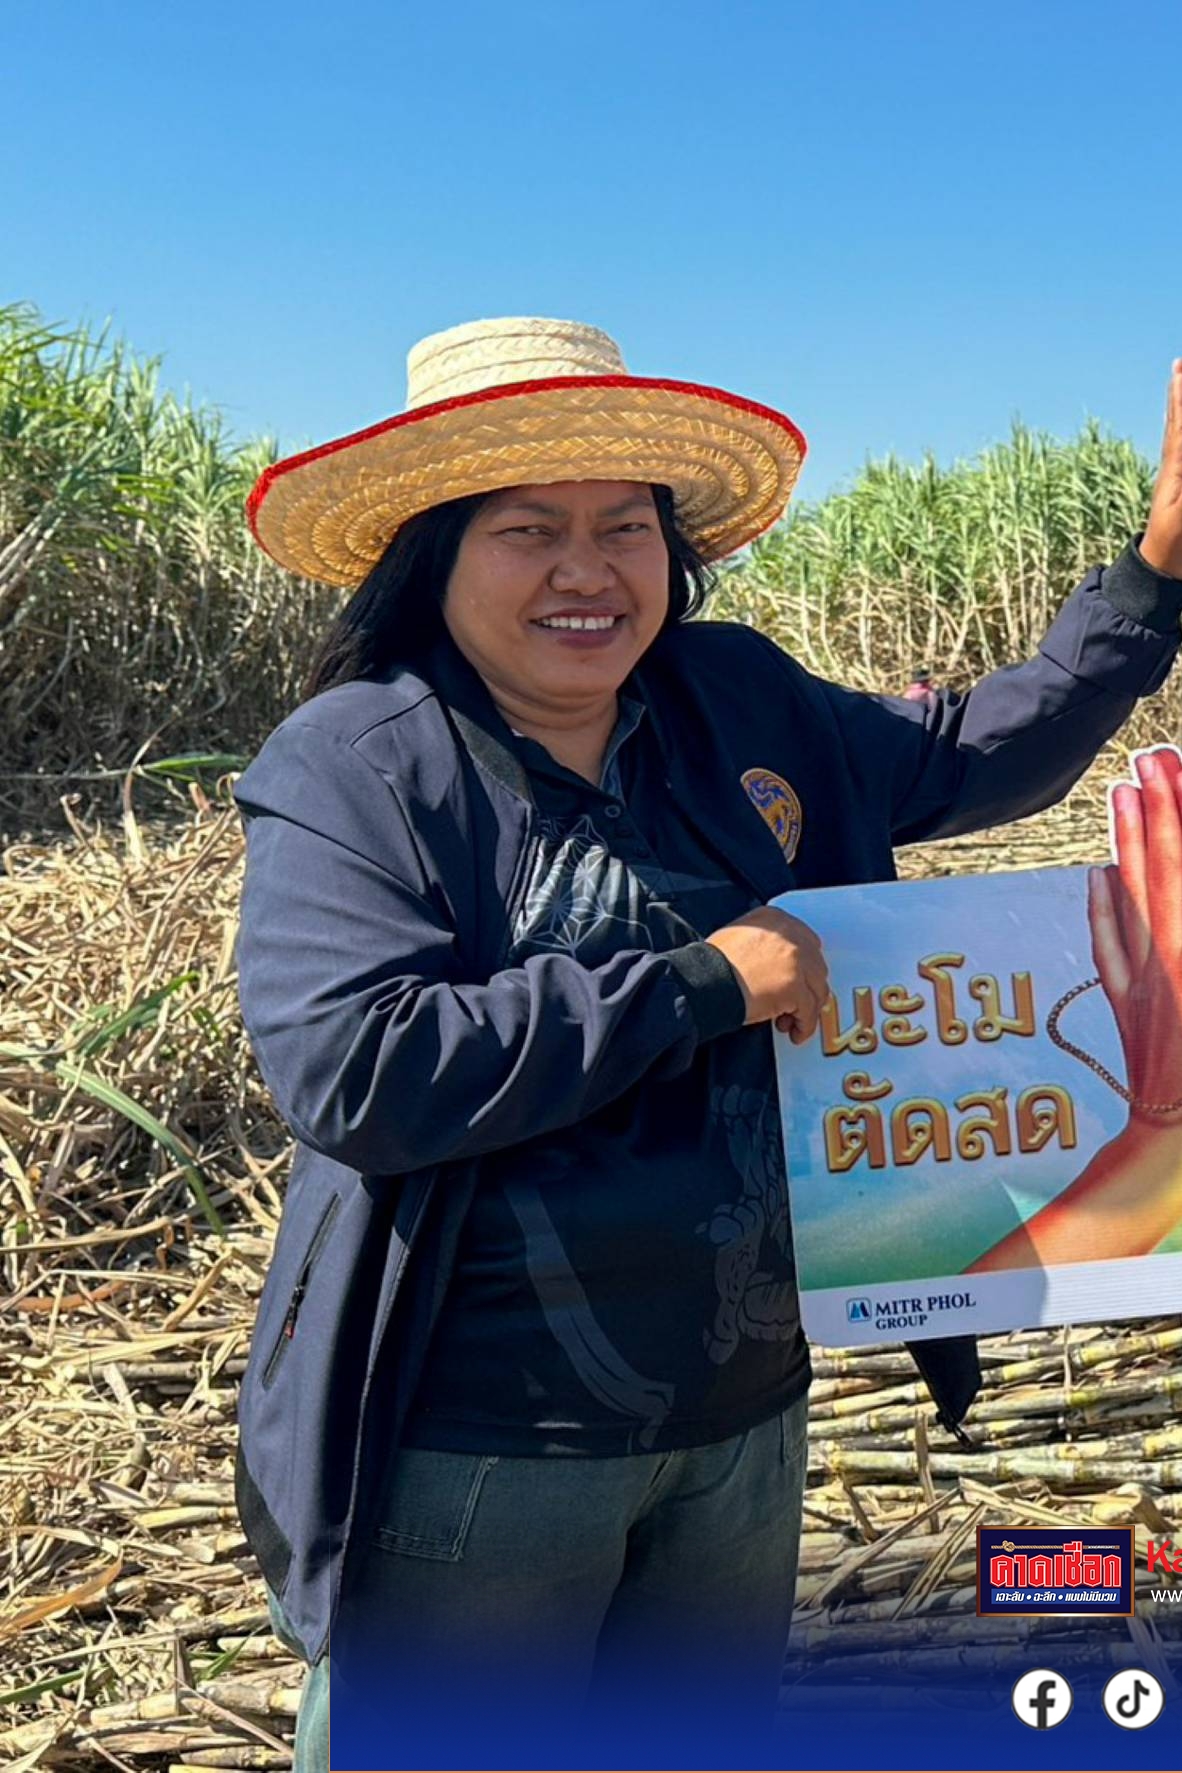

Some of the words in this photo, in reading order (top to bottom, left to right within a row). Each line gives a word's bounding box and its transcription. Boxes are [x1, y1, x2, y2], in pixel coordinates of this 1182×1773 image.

[819, 953, 1036, 1057] นะโม
[823, 1070, 1078, 1173] ตัดสด
[875, 1298, 923, 1317] MITR
[926, 1292, 977, 1312] PHOL
[875, 1313, 929, 1331] GROUP
